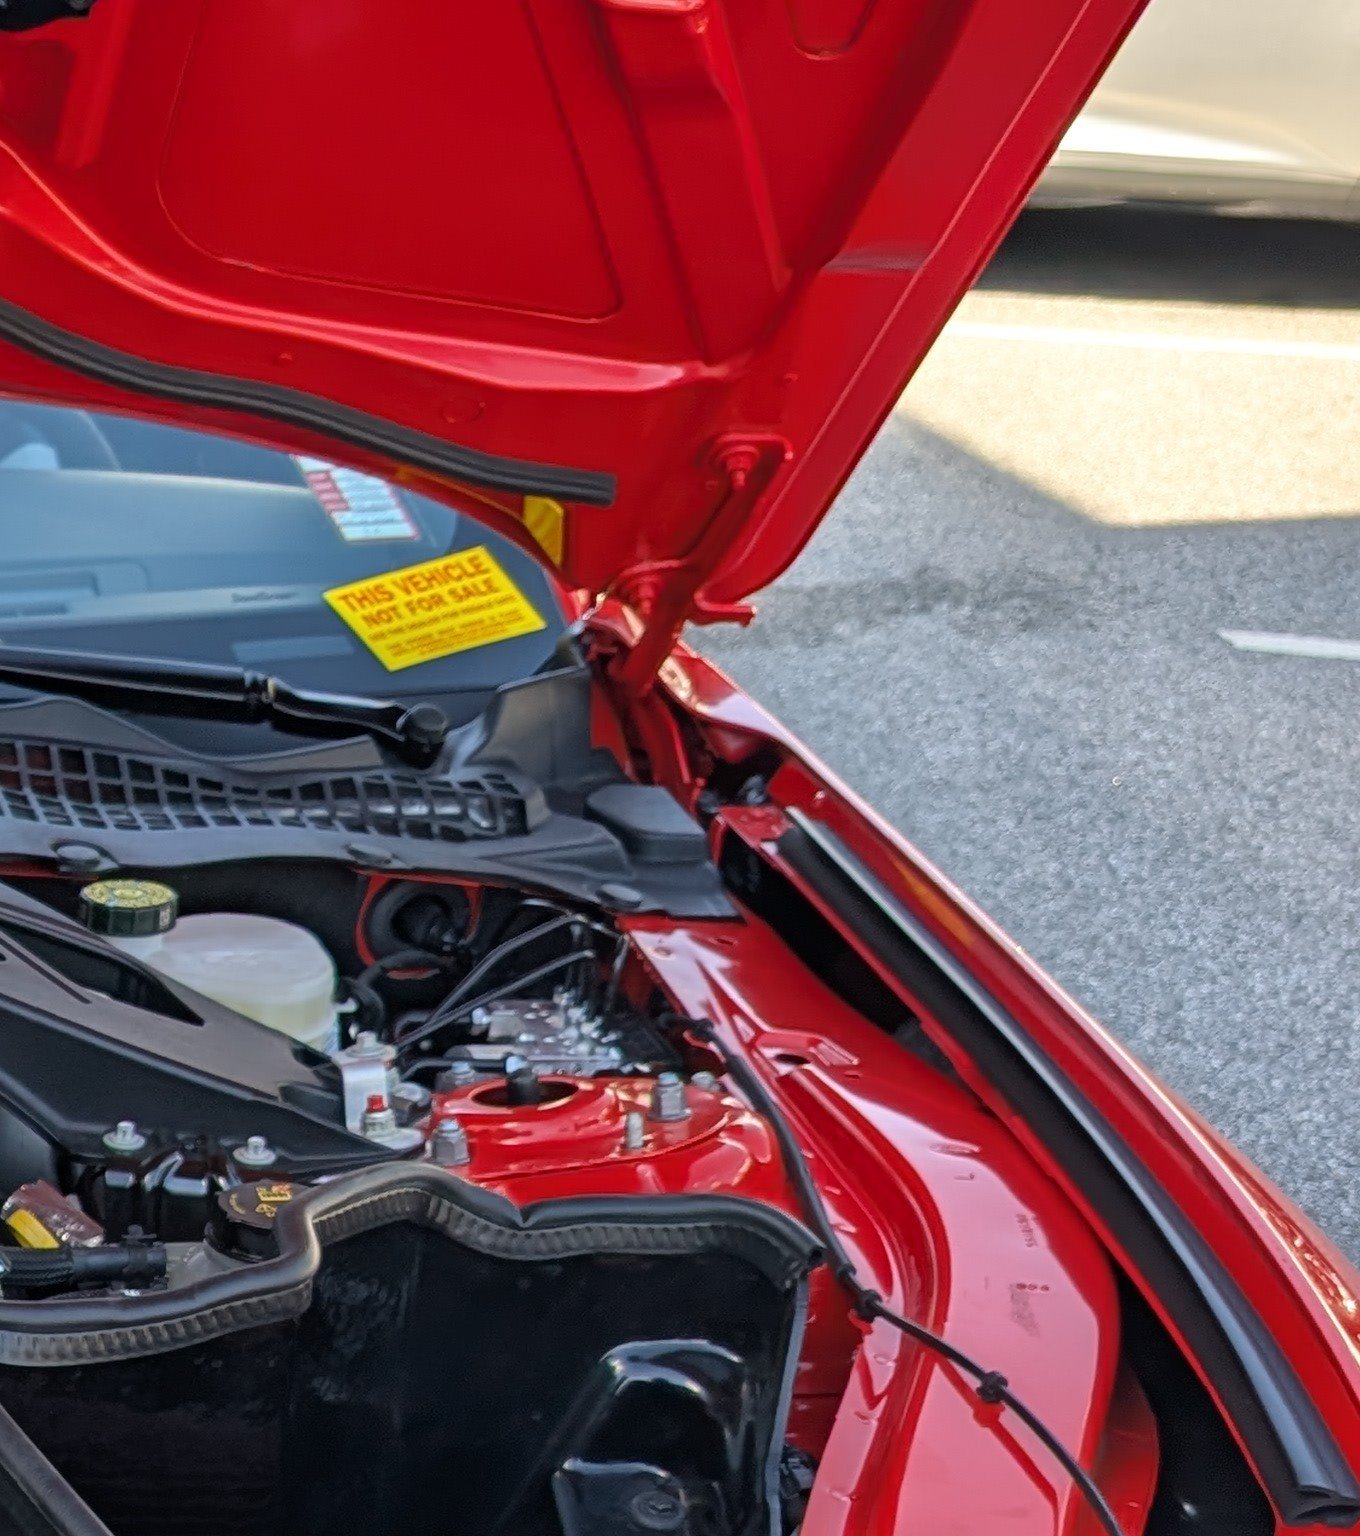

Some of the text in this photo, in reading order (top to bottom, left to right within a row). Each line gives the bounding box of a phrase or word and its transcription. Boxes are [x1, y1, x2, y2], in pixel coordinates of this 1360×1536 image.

[338, 555, 490, 613] THIS VEHICLE
[360, 605, 403, 628] NOT
[404, 592, 448, 616] FOR
[447, 577, 499, 602] SALE
